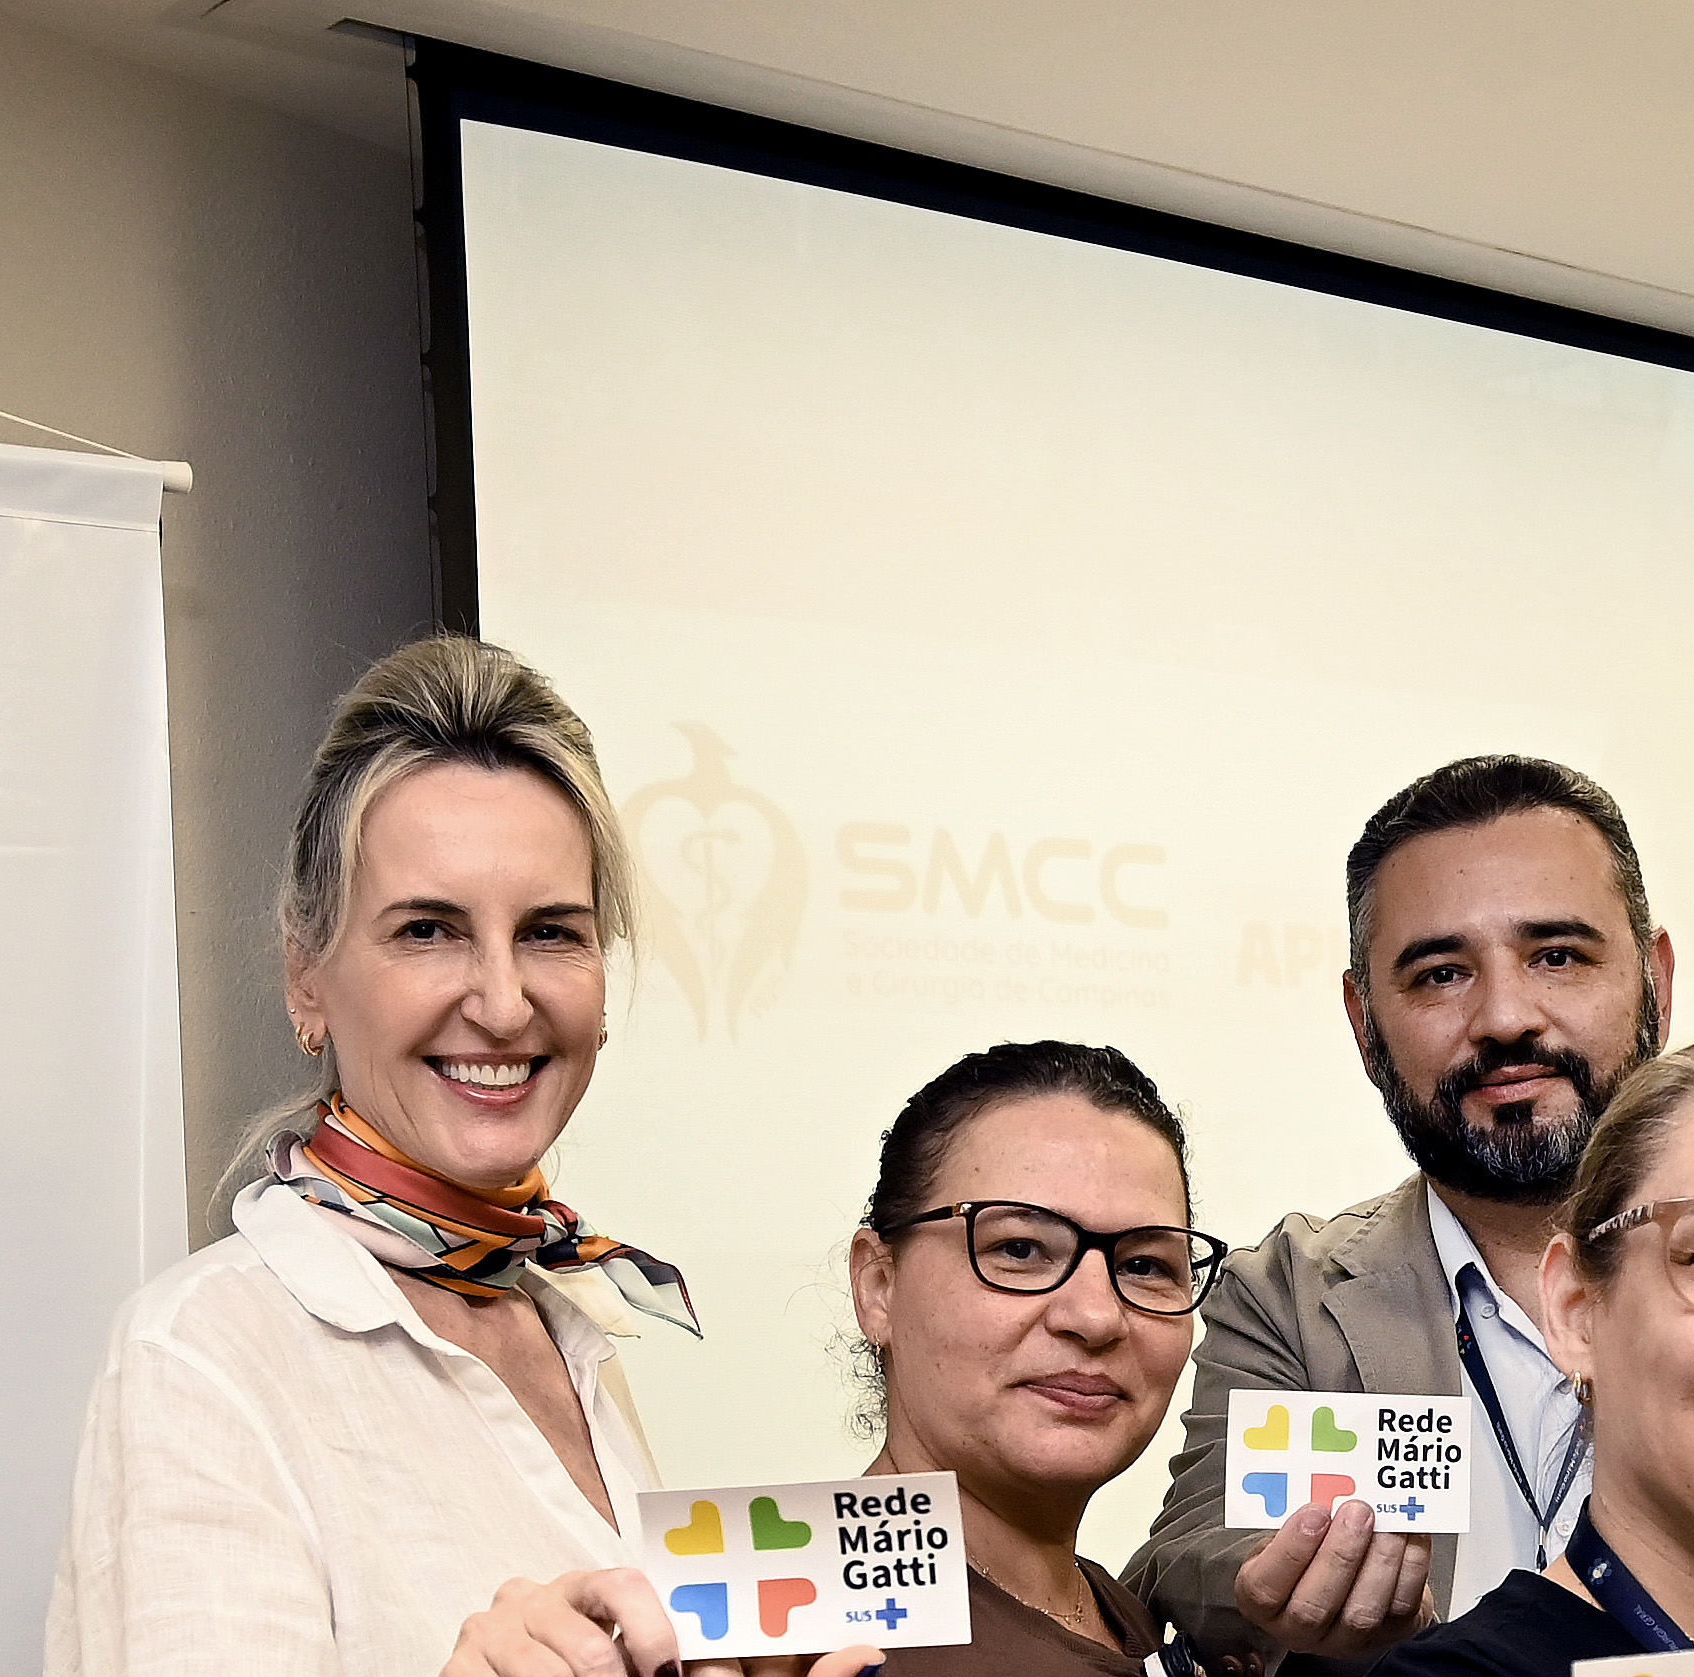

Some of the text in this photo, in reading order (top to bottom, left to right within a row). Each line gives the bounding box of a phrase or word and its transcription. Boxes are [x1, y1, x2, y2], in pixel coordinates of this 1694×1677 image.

[837, 821, 1169, 928] SMCC
[1378, 1408, 1453, 1434] Rede
[1377, 1435, 1462, 1463] Mário
[1377, 1464, 1450, 1490] Gatti
[833, 1486, 932, 1519] Rede
[1376, 1503, 1398, 1514] SUS
[838, 1519, 948, 1555] Mário
[842, 1552, 937, 1590] Gatti
[845, 1609, 873, 1624] SUS
